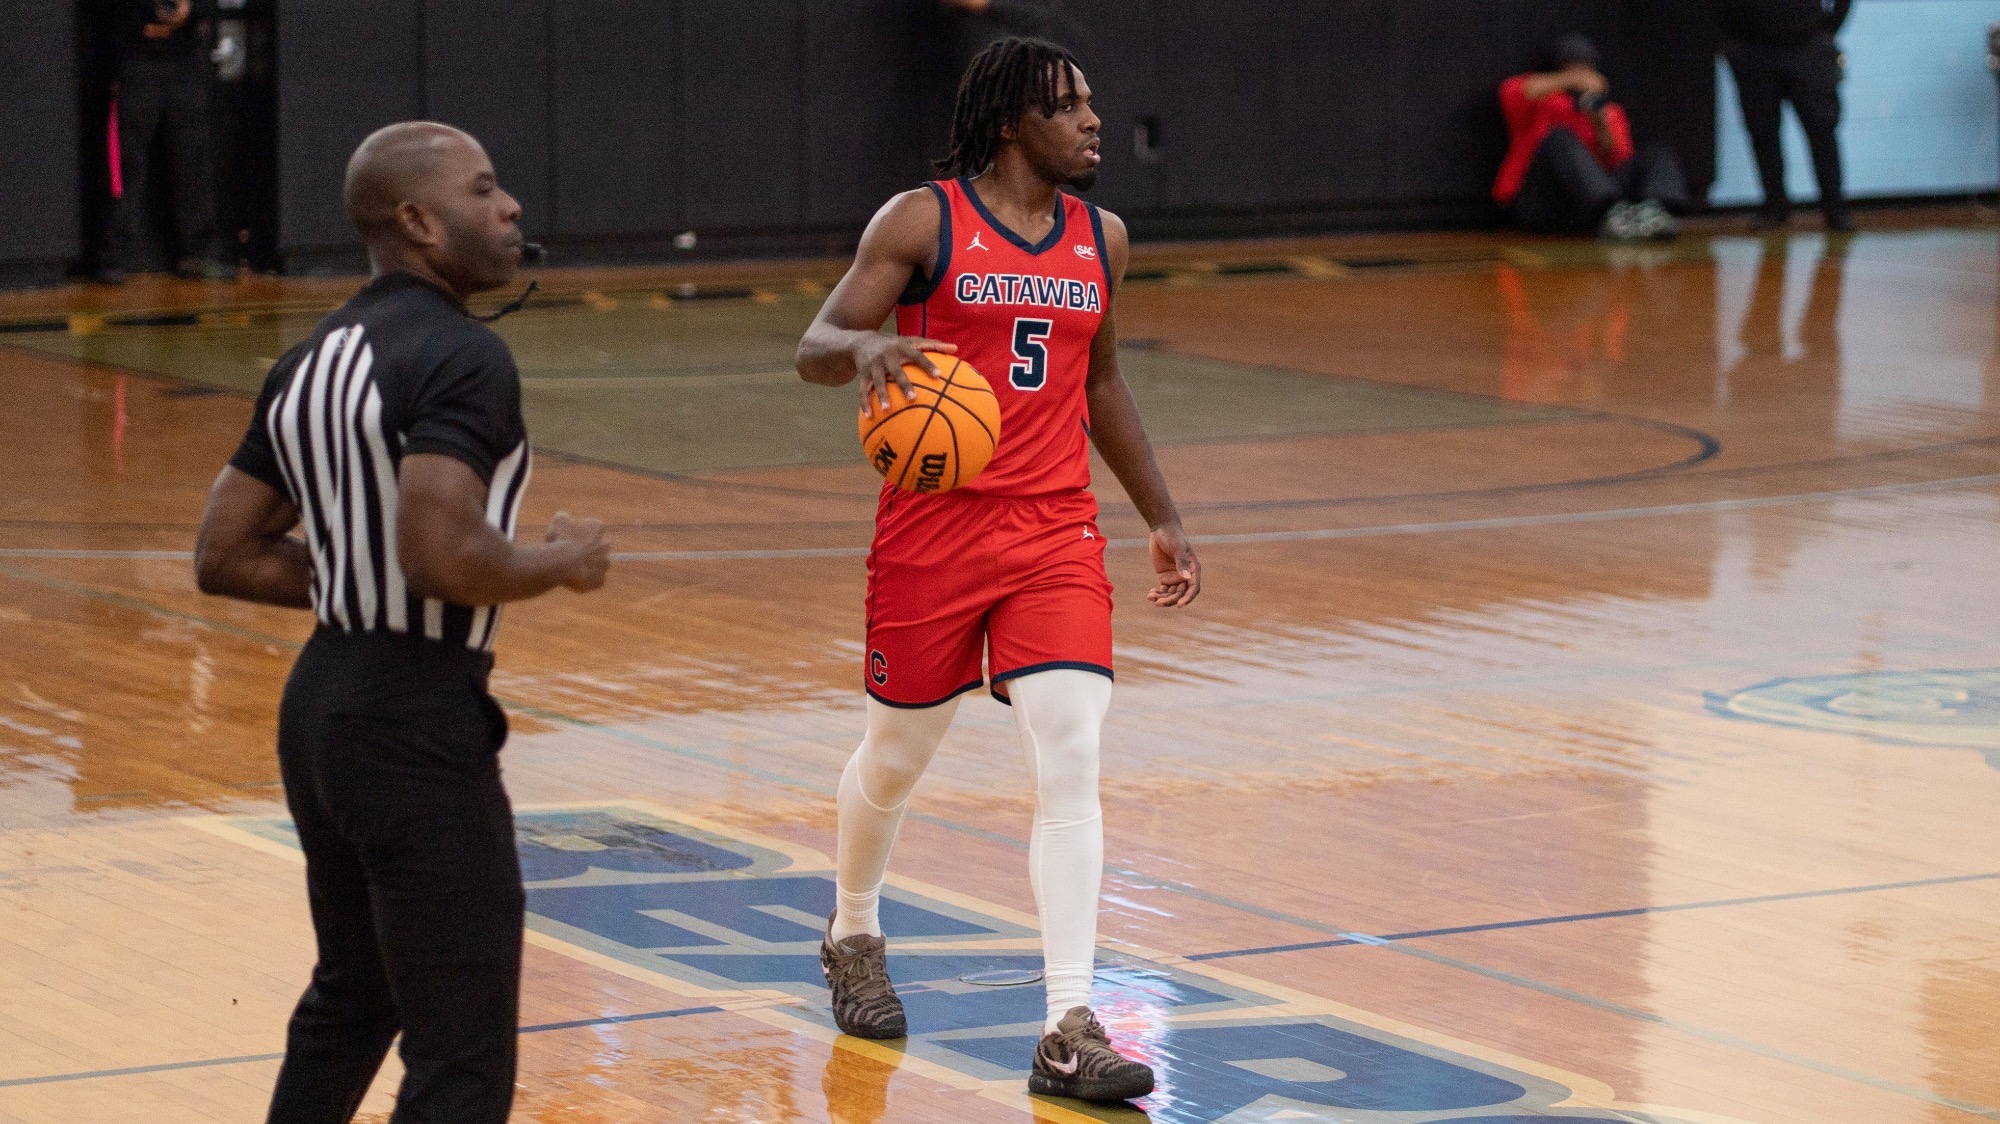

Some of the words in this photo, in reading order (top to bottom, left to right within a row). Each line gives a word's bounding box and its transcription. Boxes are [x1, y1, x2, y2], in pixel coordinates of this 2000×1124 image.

[1076, 245, 1095, 256] SAC
[955, 273, 1101, 313] CATAWBA
[1008, 317, 1053, 391] 5
[873, 441, 898, 478] NC
[870, 649, 887, 686] C
[300, 803, 1580, 1124] BEAR
